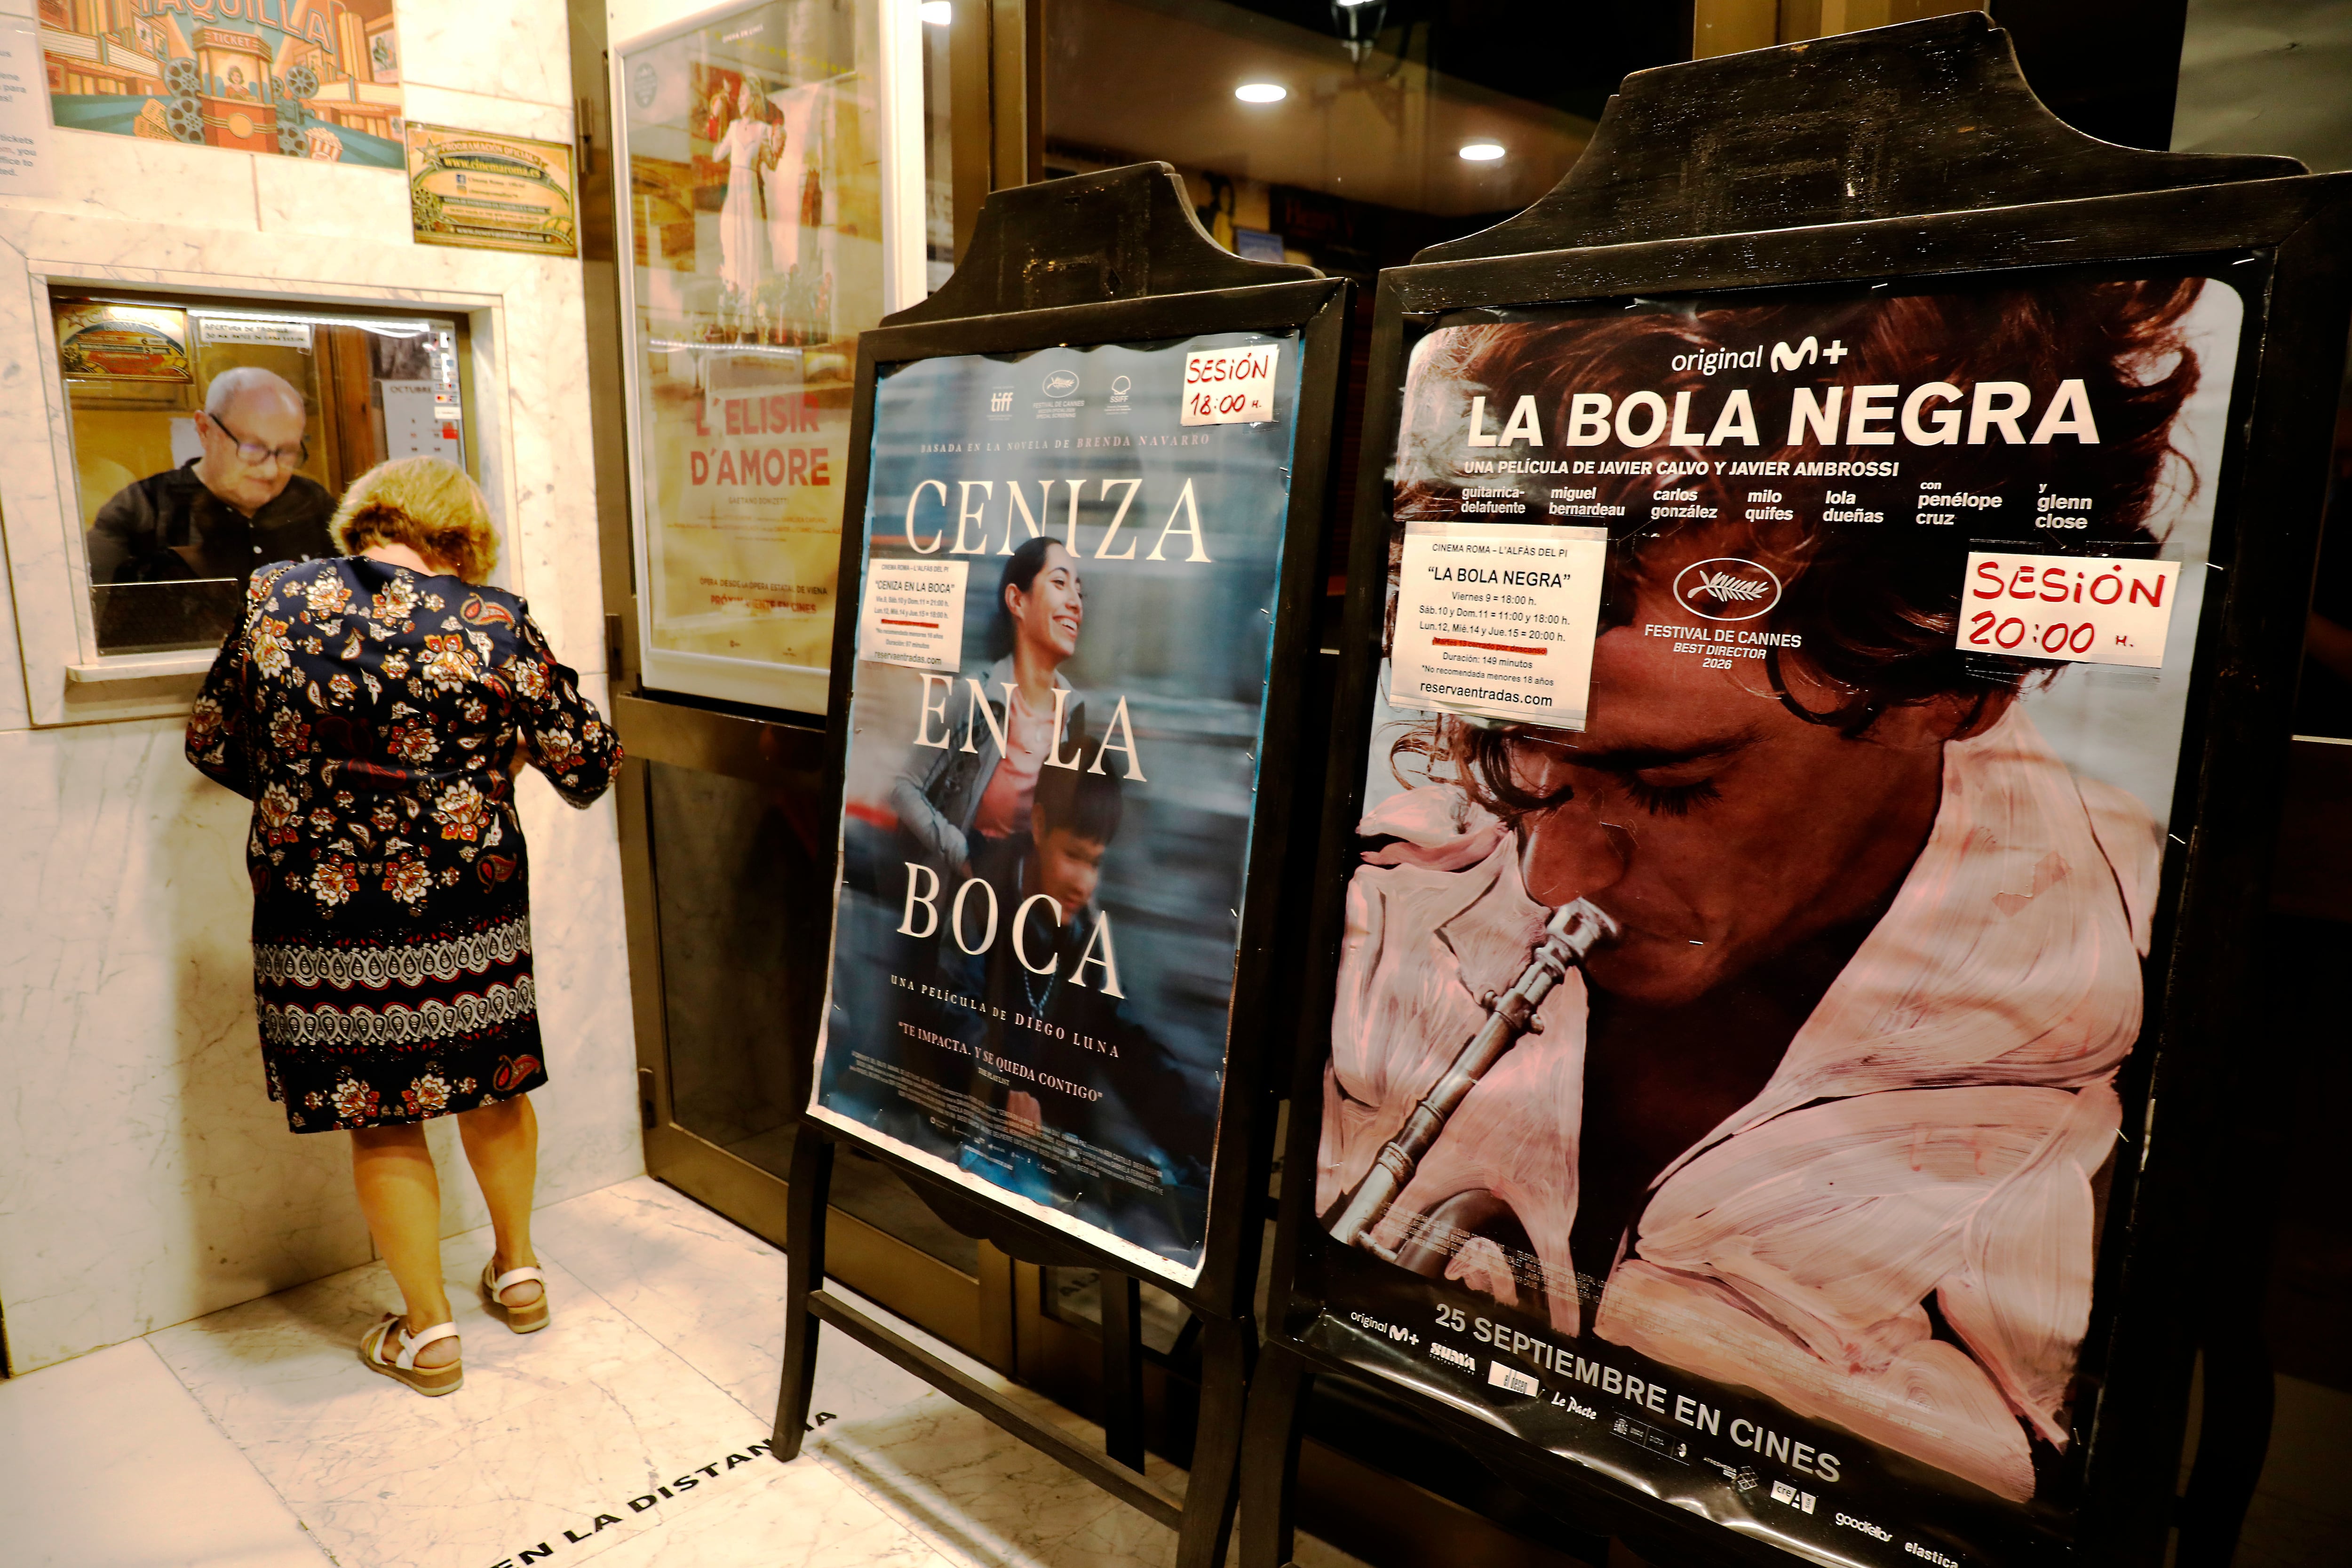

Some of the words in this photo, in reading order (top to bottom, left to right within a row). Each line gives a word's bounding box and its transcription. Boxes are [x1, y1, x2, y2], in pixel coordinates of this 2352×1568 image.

[212, 32, 251, 47] TICKET
[1671, 344, 1764, 376] original
[991, 391, 1014, 412] tiff
[1191, 392, 1246, 416] 18:00
[696, 393, 820, 437] L'ELISIR
[1467, 394, 1544, 447] LA
[1566, 389, 1760, 448] BOLA
[1787, 379, 2100, 446] NEGRA
[967, 443, 981, 452] EN
[986, 443, 1001, 452] LA
[1007, 440, 1049, 452] NOVELA
[1055, 439, 1070, 449] DE
[1076, 436, 1131, 448] BRENDA
[1138, 434, 1210, 446] NAVARRO
[691, 447, 831, 486] D'AMORE
[1463, 461, 1494, 475] UNA
[1497, 457, 1570, 475] PELÍCULA
[1572, 461, 1597, 475] DE
[1597, 461, 1653, 475] JAVIER
[1655, 461, 1709, 476] CALVO
[1715, 462, 1728, 476] Y
[1728, 462, 1790, 477] JAVIER
[1793, 461, 1900, 477] AMBROSSI
[1462, 486, 1525, 501] guitarrica-
[1550, 486, 1597, 501] miguel
[1920, 481, 1942, 490] con
[2039, 484, 2048, 493] y
[1652, 488, 1699, 502] carlos
[1747, 489, 1782, 503] milo
[1825, 491, 1857, 505] lola
[1917, 492, 2003, 510] penélope
[2036, 495, 2093, 512] glenn
[1461, 500, 1526, 514] delafuente
[1548, 502, 1626, 517] bernardeau
[1650, 504, 1718, 519] gonzález
[1822, 508, 1884, 524] dueñas
[906, 477, 1215, 564] CENIZA
[1915, 512, 1955, 526] cruz
[2034, 514, 2088, 530] close
[1432, 543, 1464, 553] CINEMA
[1466, 545, 1491, 554] ROMA
[1538, 548, 1556, 557] DEL
[1558, 549, 1568, 558] PI
[1457, 568, 1498, 584] BOLA
[807, 586, 828, 596] VIENA
[904, 581, 915, 592] EN
[917, 582, 926, 591] LA
[1451, 591, 1484, 603] Viernes
[1485, 593, 1491, 602] 9
[1501, 594, 1526, 605] 18:00
[1528, 597, 1537, 606] h.
[1419, 605, 1448, 615] Sáb.10
[1449, 609, 1455, 617] y
[1456, 608, 1488, 619] Dom.11
[1498, 611, 1524, 621] 11:00
[1525, 614, 1532, 624] y
[1534, 614, 1560, 625] 18:00
[1561, 616, 1570, 626] h.
[1419, 621, 1451, 634] Lun.12,
[1452, 623, 1479, 635] Mié.14
[1480, 628, 1487, 637] y
[1488, 626, 1519, 638] Jue.15
[1529, 630, 1555, 641] 20:00
[1557, 632, 1566, 642] h.
[1644, 623, 1712, 641] FESTIVAL
[1714, 629, 1735, 643] DE
[1737, 630, 1803, 648] CANNES
[1969, 610, 2096, 654] 20:00
[874, 650, 942, 665] reservaentradas.com
[1672, 642, 1706, 654] BEST
[1706, 644, 1767, 660] DIRECTOR
[1442, 652, 1480, 664] Duración:
[1482, 656, 1497, 666] 149
[1498, 657, 1534, 669] minutos
[1701, 657, 1733, 670] 2026
[1435, 667, 1486, 680] recomendada
[1486, 671, 1521, 684] menores
[1522, 675, 1534, 685] 18
[1534, 677, 1554, 687] años
[1420, 681, 1553, 708] reservaentradas.com
[913, 672, 1019, 759] EN
[1044, 687, 1148, 783] LA
[897, 861, 1125, 1000] BOCA
[890, 974, 914, 991] UNA
[921, 984, 987, 1013] PELÍCULA
[992, 1006, 1007, 1021] DE
[1014, 1012, 1066, 1040] DIEGO
[1073, 1032, 1120, 1059] LUNA
[918, 1027, 972, 1056] IMPACTA.
[974, 1045, 983, 1059] Y
[982, 1050, 994, 1065] SE
[995, 1056, 1036, 1082] QUEDA
[1351, 1312, 1388, 1333] original
[1435, 1303, 1467, 1332] 25
[1473, 1316, 1668, 1414] SEPTIEMBRE
[1674, 1394, 1721, 1436] EN
[1730, 1418, 1842, 1483] CINES
[1551, 1391, 1567, 1408] Le
[1568, 1395, 1597, 1420] Pacte
[563, 1513, 623, 1544] LA
[627, 1411, 837, 1513] DISTANIA
[1904, 1541, 1959, 1568] elastica
